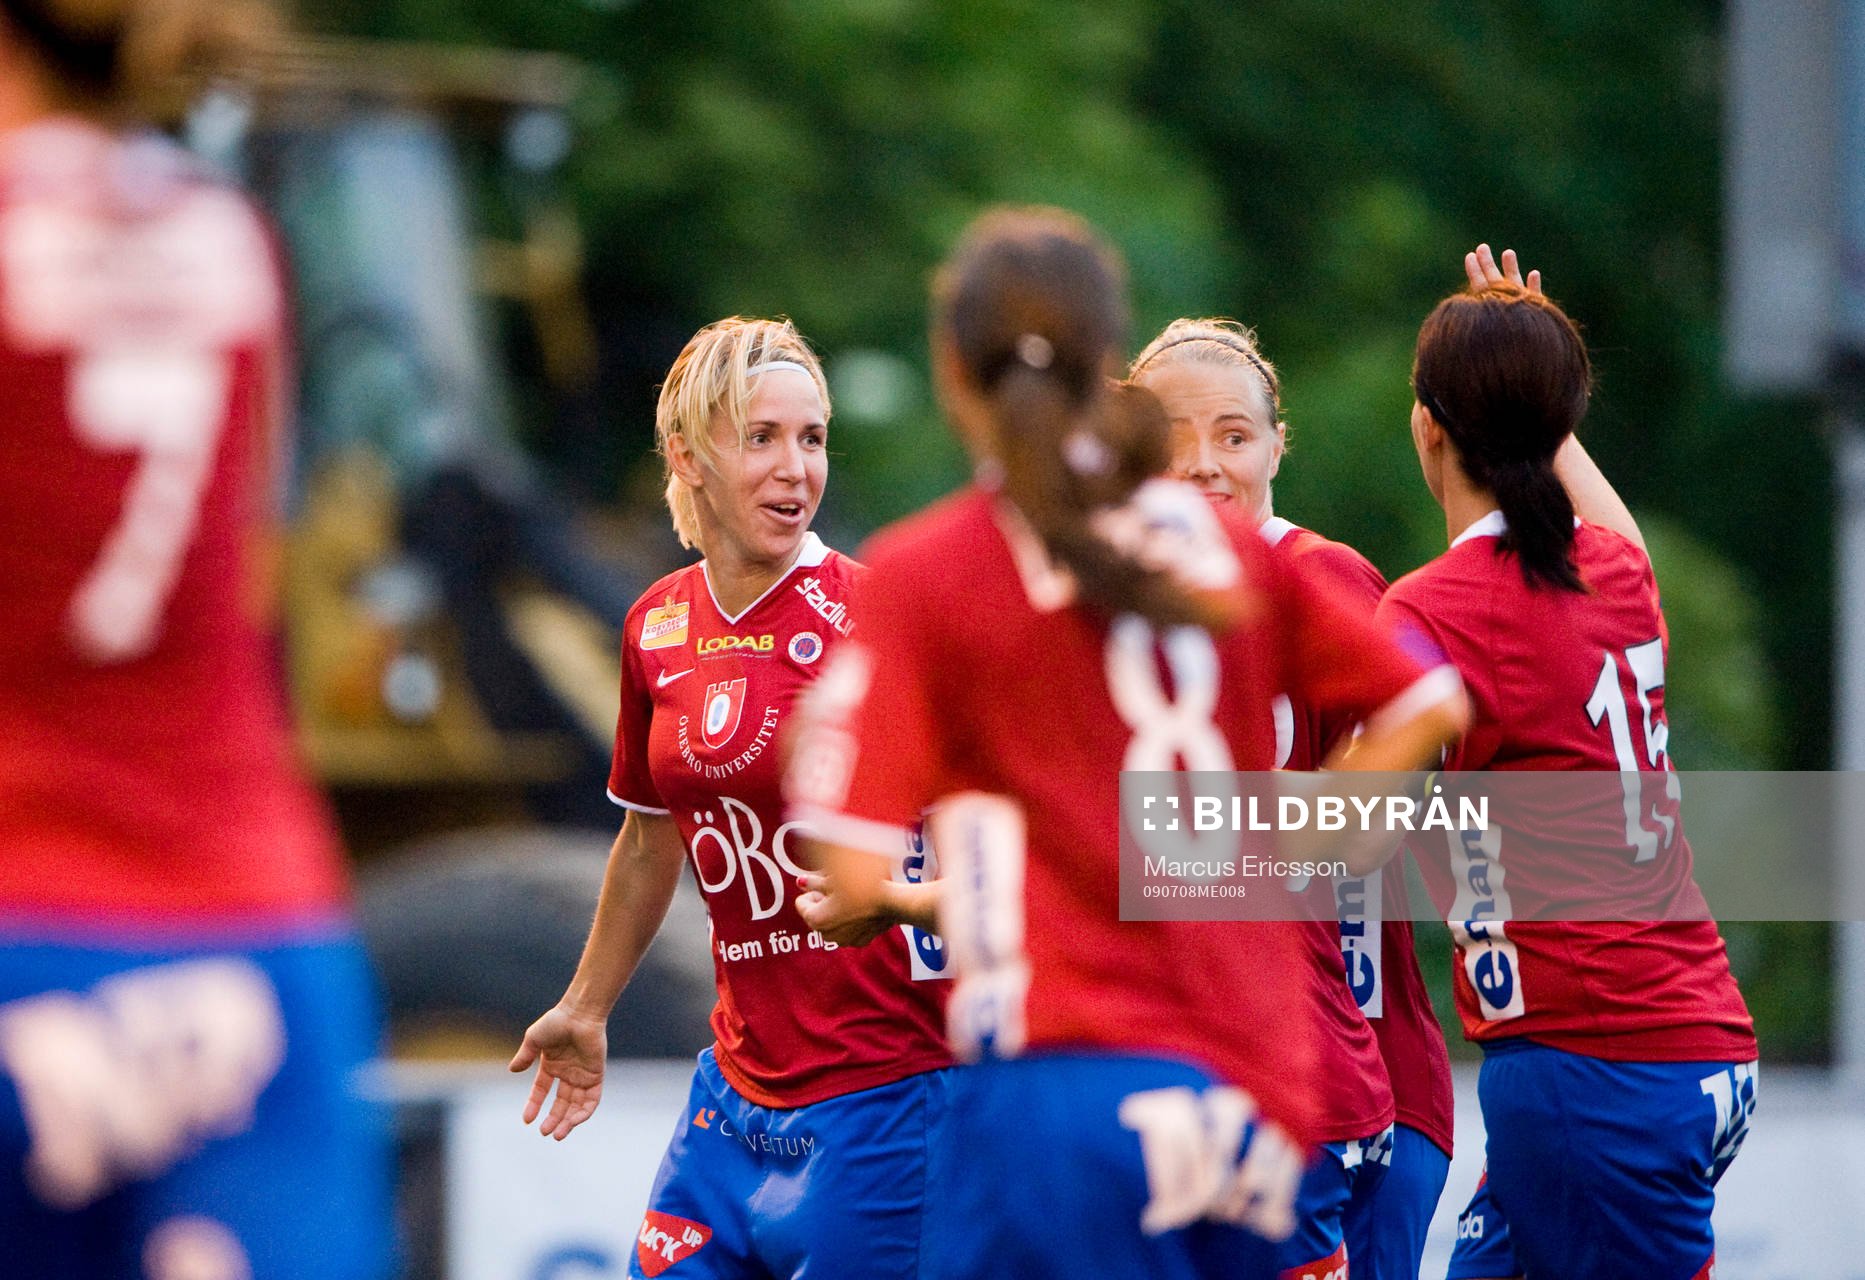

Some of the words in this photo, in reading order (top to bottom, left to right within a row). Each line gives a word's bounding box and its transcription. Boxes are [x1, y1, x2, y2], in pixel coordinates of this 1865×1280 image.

[66, 343, 228, 662] 7
[697, 634, 775, 655] LODAB
[705, 706, 780, 779] UNIVERSITET
[1104, 614, 1241, 884] 8
[769, 929, 800, 955] för
[681, 1225, 703, 1248] UP
